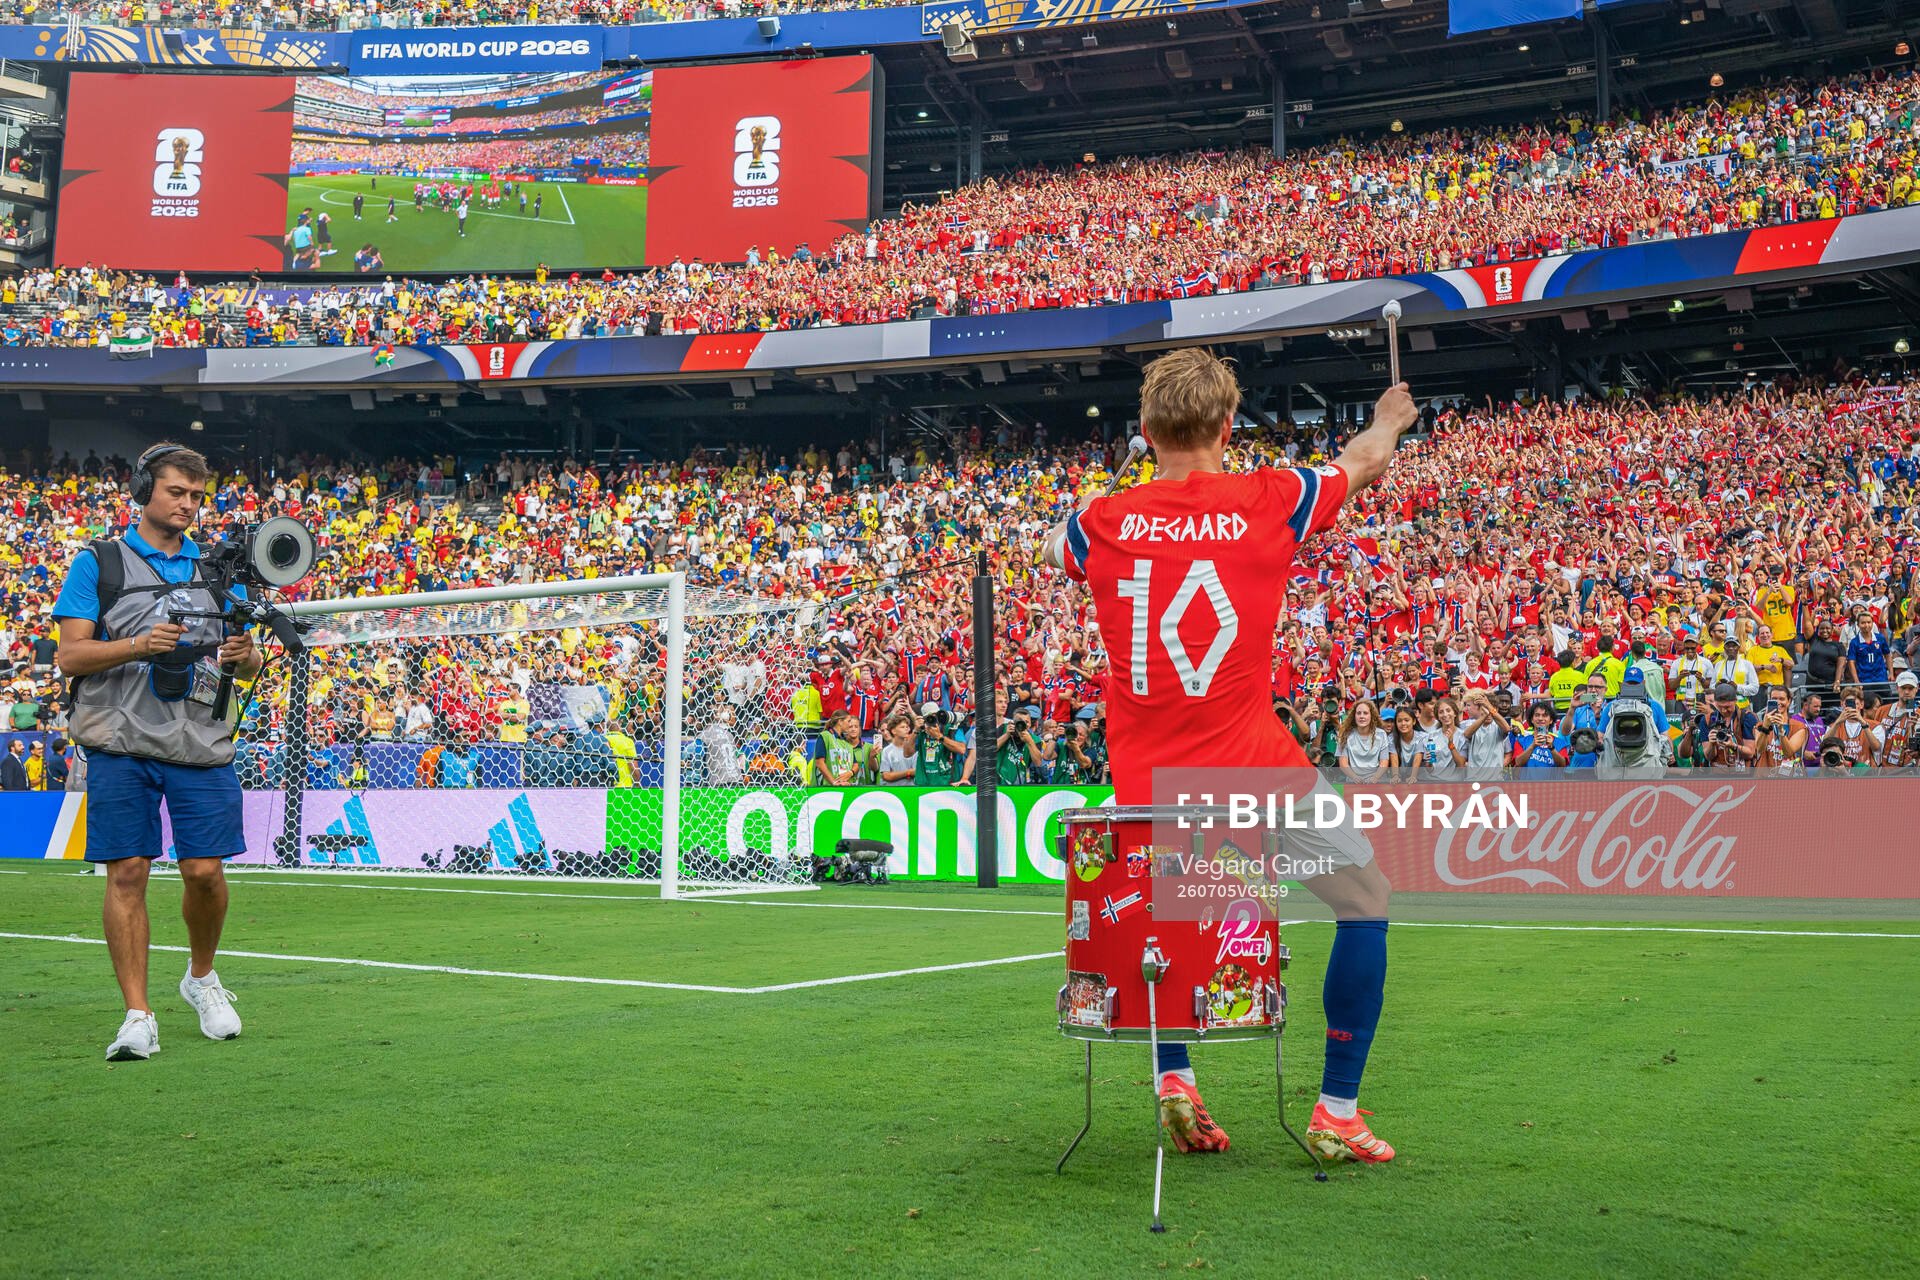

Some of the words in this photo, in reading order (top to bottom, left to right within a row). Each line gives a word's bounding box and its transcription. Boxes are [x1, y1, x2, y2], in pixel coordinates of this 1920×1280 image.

[361, 43, 403, 59] FIFA
[405, 42, 476, 58] WORLD
[479, 41, 519, 57] CUP
[520, 39, 590, 56] 2026
[604, 178, 637, 186] Lenovo
[746, 172, 767, 180] FIFA
[166, 182, 188, 191] FIFA
[732, 189, 762, 197] WORLD
[762, 187, 779, 195] CUP
[732, 194, 779, 208] 2026
[150, 205, 199, 217] 2026
[1117, 512, 1249, 542] ØDEGAARD
[1117, 559, 1239, 697] 10
[1433, 784, 1757, 889] Coca-Cola
